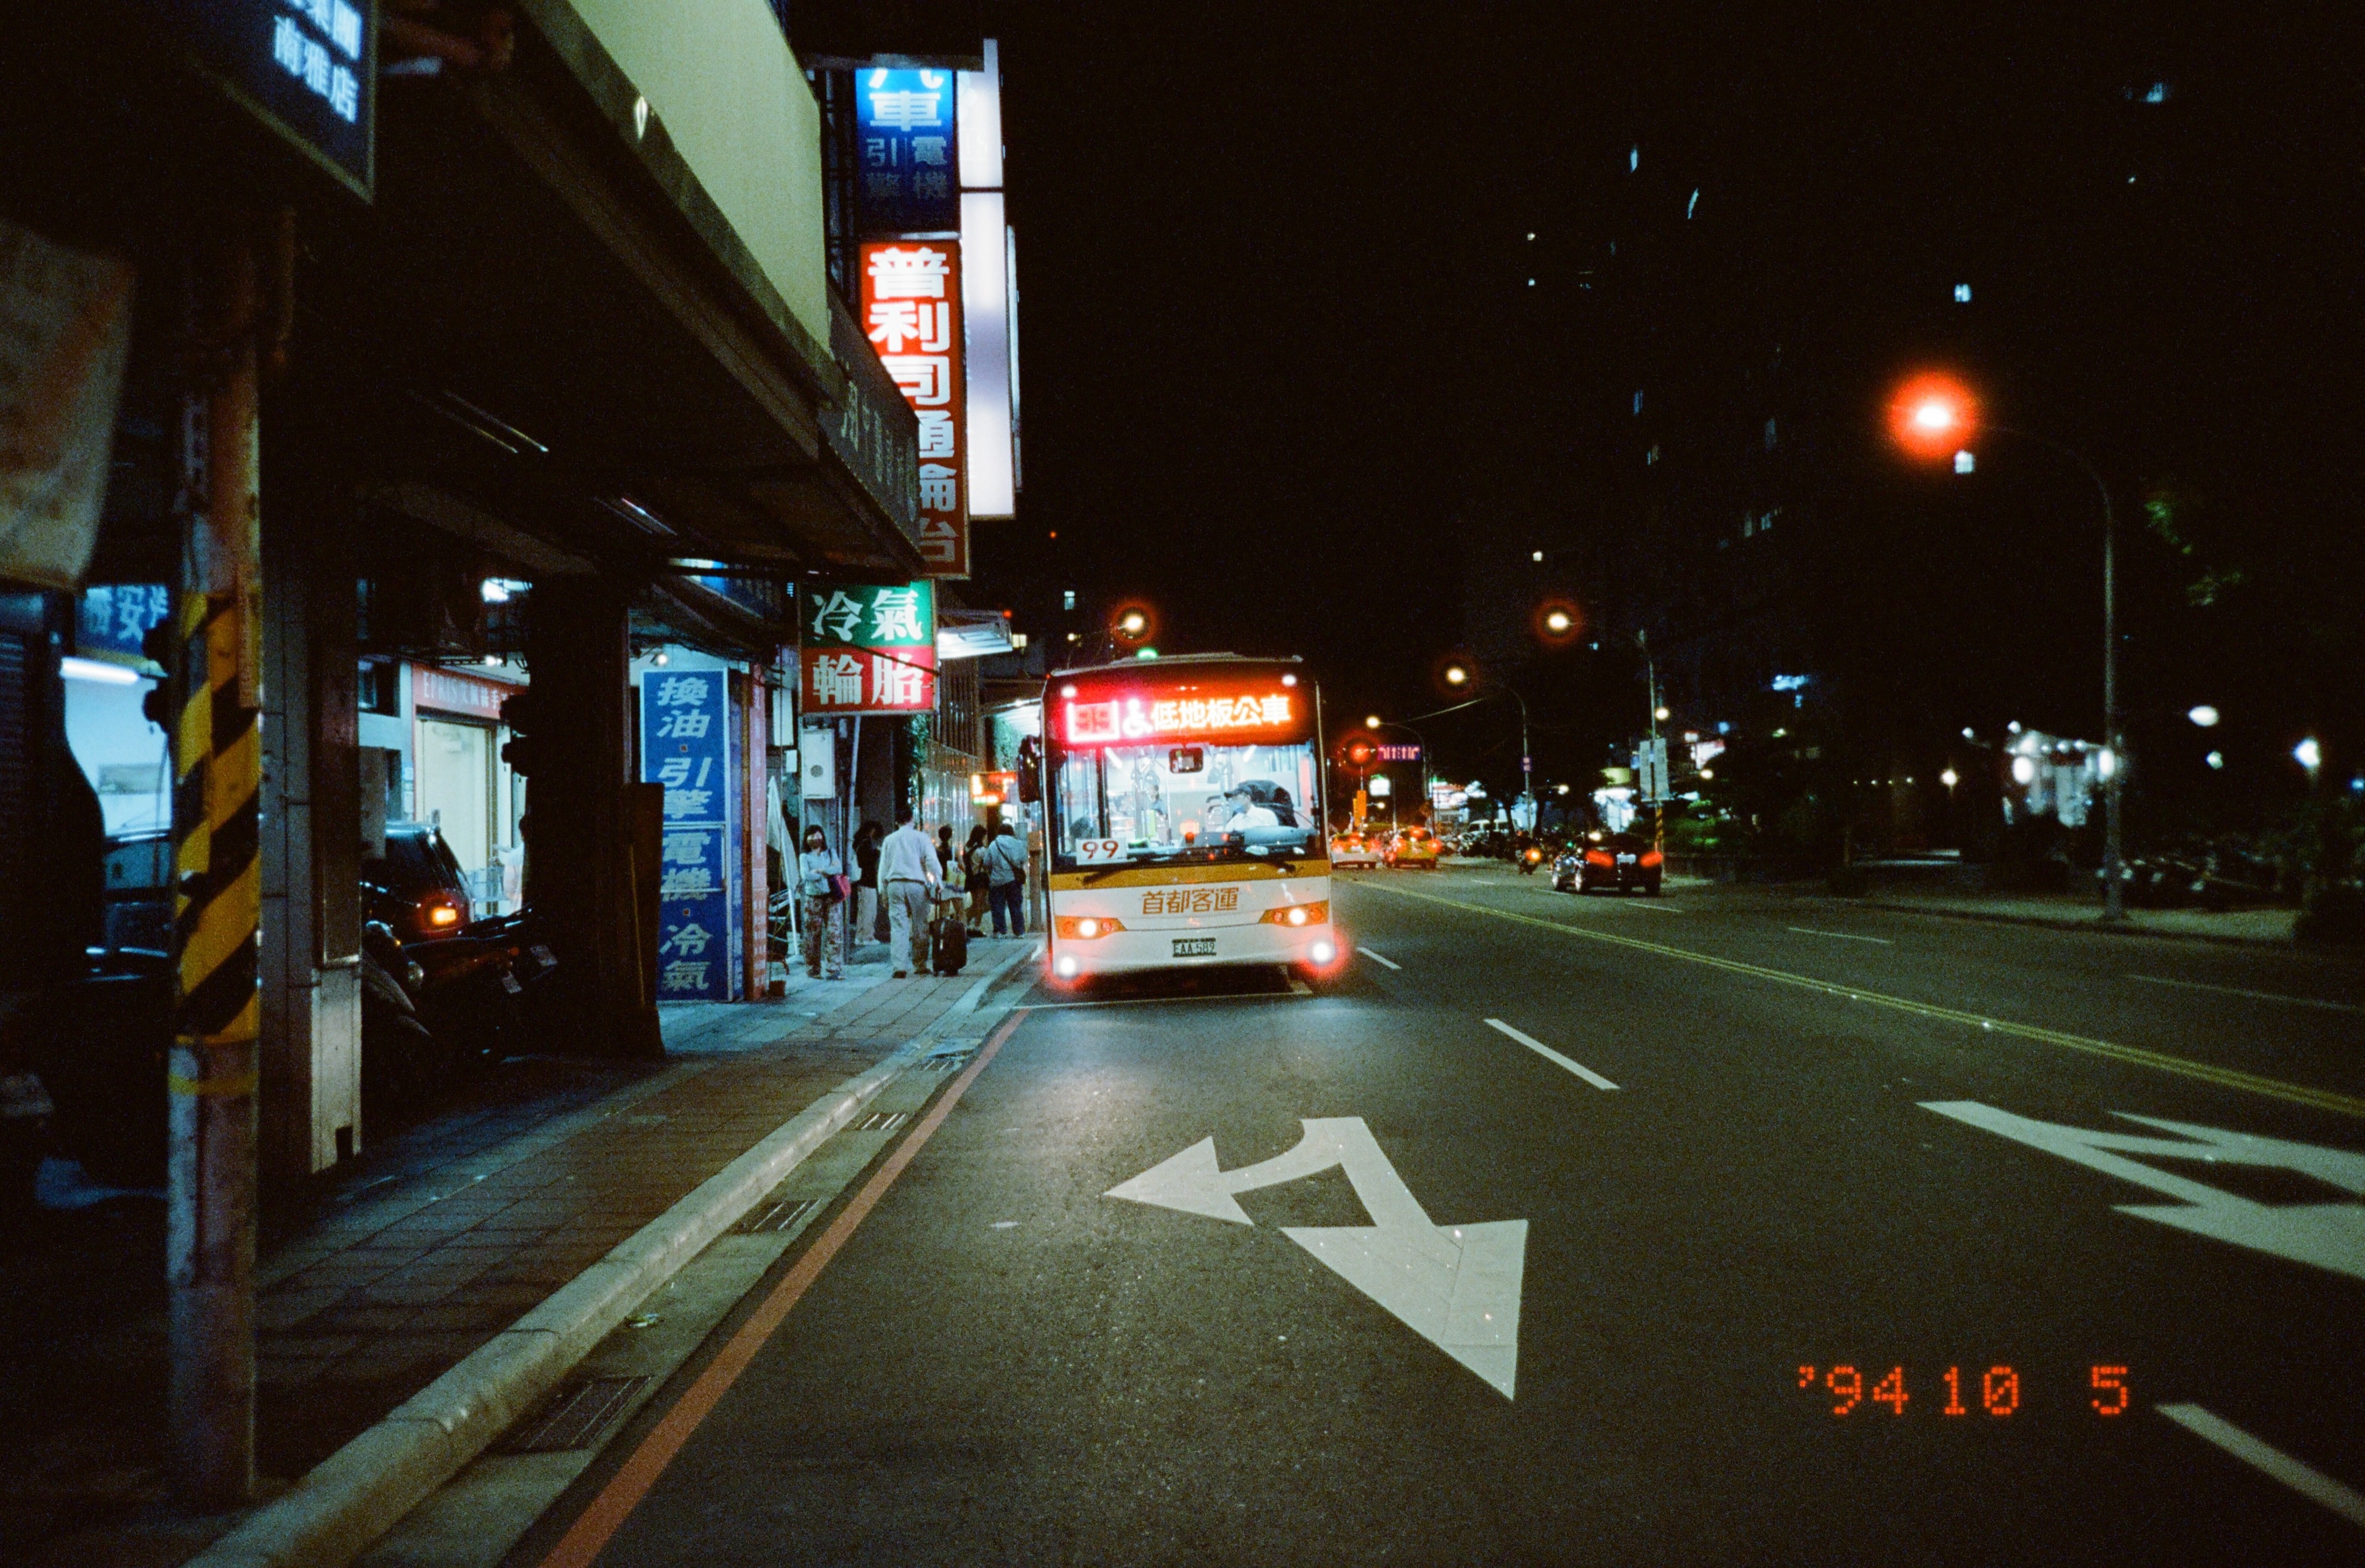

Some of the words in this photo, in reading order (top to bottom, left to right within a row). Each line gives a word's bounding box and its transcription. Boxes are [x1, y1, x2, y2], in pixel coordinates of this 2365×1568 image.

[811, 589, 923, 643] 冷氣
[812, 652, 925, 706] 輪胎
[657, 676, 710, 738] 換油
[1150, 695, 1291, 730] 低地板公車
[658, 756, 713, 820] 引擎
[661, 831, 712, 902] 電機
[1081, 840, 1119, 860] 99
[1142, 887, 1240, 915] 首都客運
[660, 923, 713, 992] 冷氣
